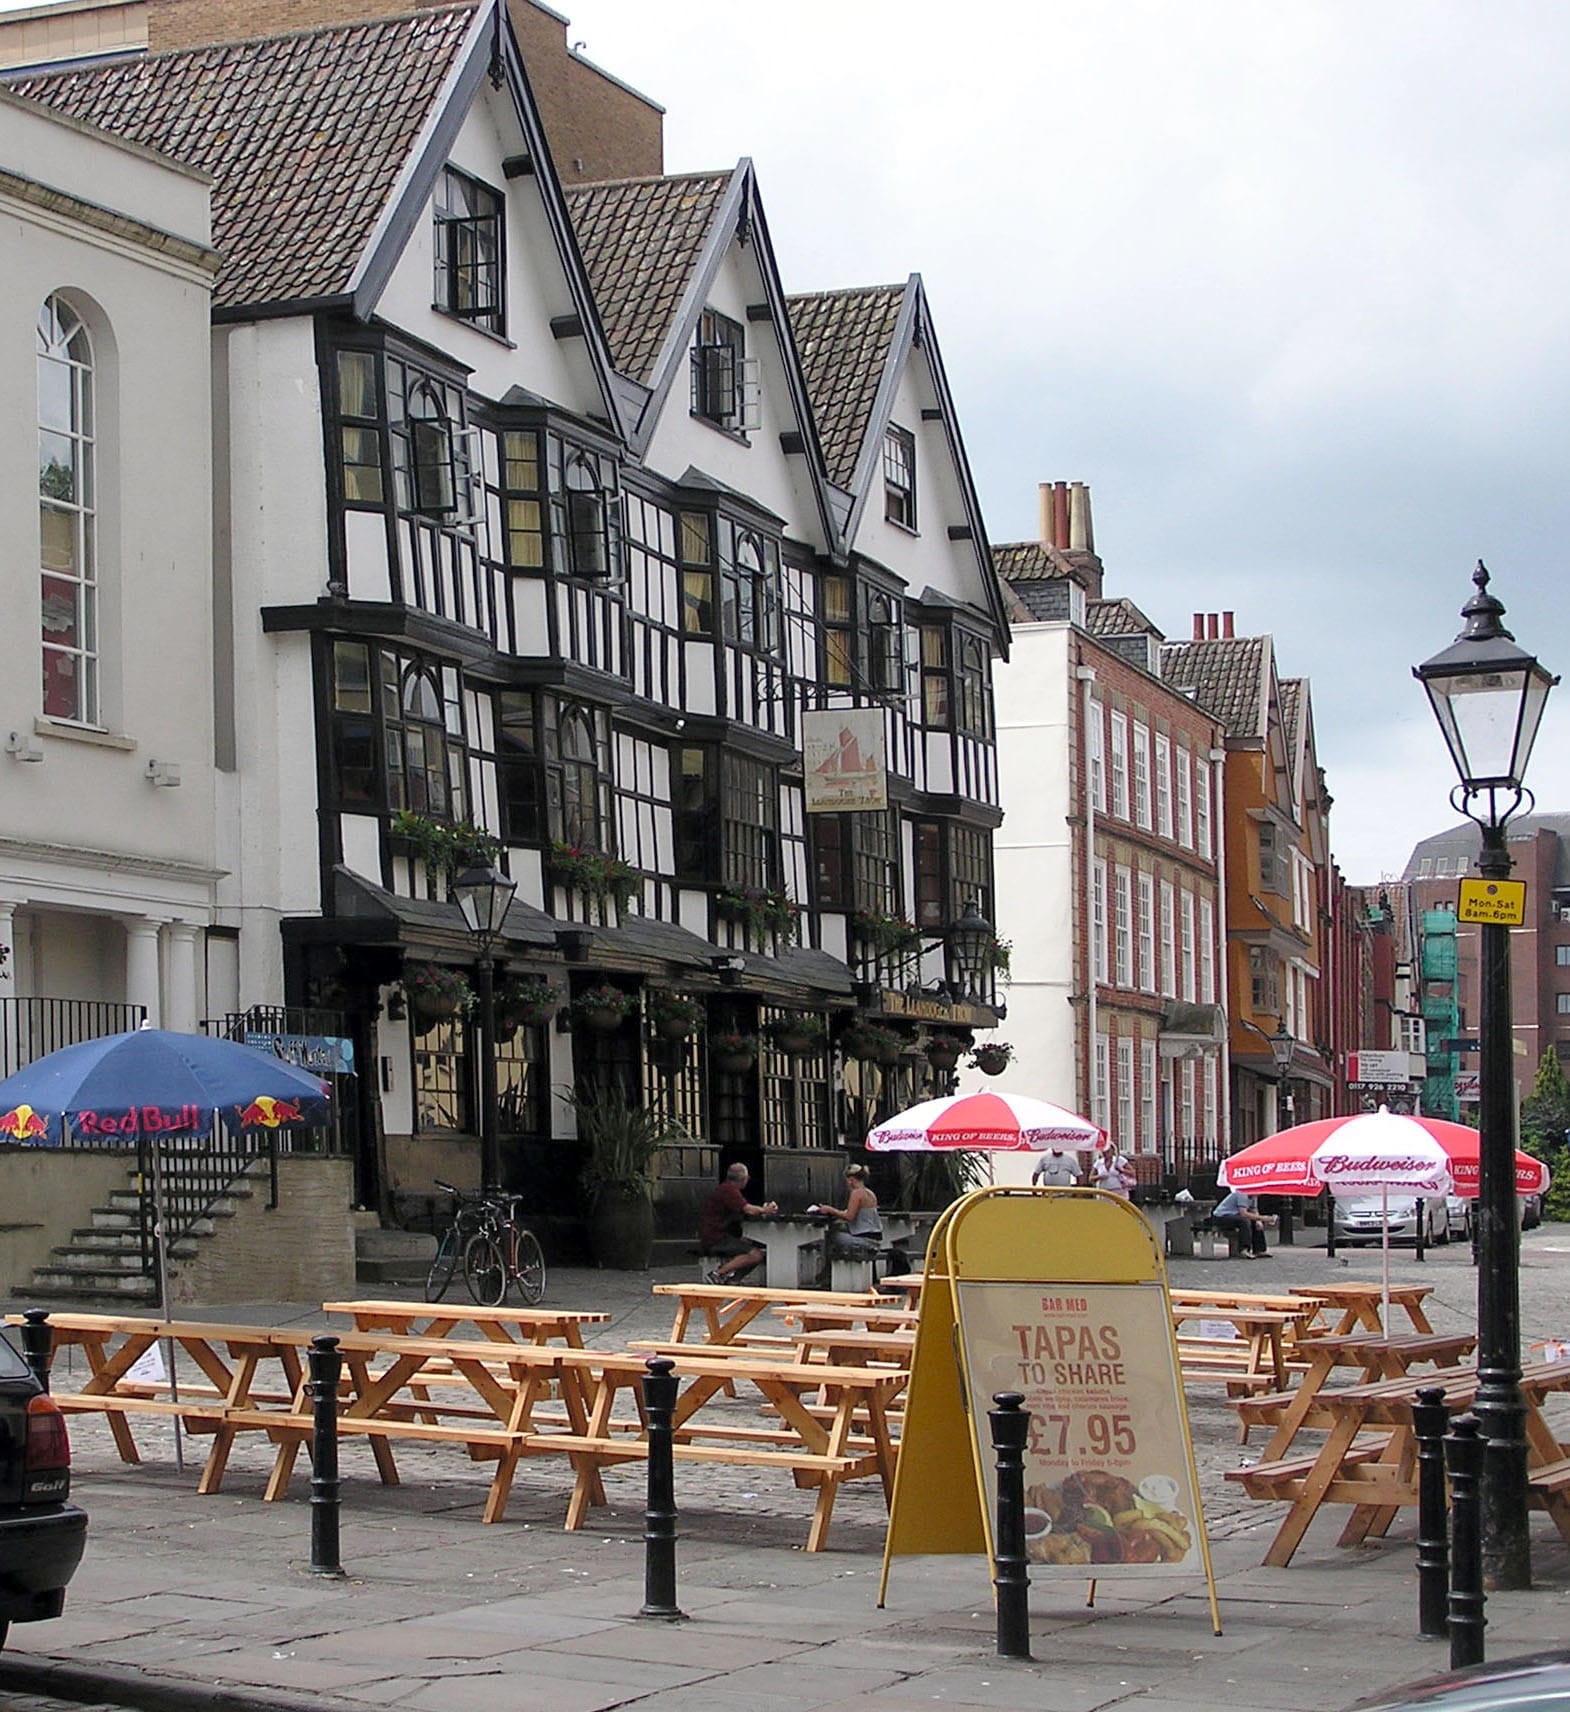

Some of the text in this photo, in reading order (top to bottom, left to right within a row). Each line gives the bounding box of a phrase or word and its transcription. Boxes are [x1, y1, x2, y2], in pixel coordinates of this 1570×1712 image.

[78, 1104, 199, 1134] Red Bull
[931, 1132, 960, 1142] KING
[963, 1132, 977, 1141] OF
[1026, 1128, 1092, 1143] Budweiser
[1232, 1165, 1260, 1178] KING
[1261, 1163, 1275, 1174] OF
[1318, 1155, 1437, 1174] Budweiser
[1453, 1164, 1479, 1175] KING
[1041, 1297, 1088, 1312] BAR MED
[1012, 1325, 1121, 1361] TAPAS
[1017, 1362, 1126, 1385] TO SHARE
[1028, 1413, 1137, 1456] £7.95
[30, 1480, 66, 1491] Golf
